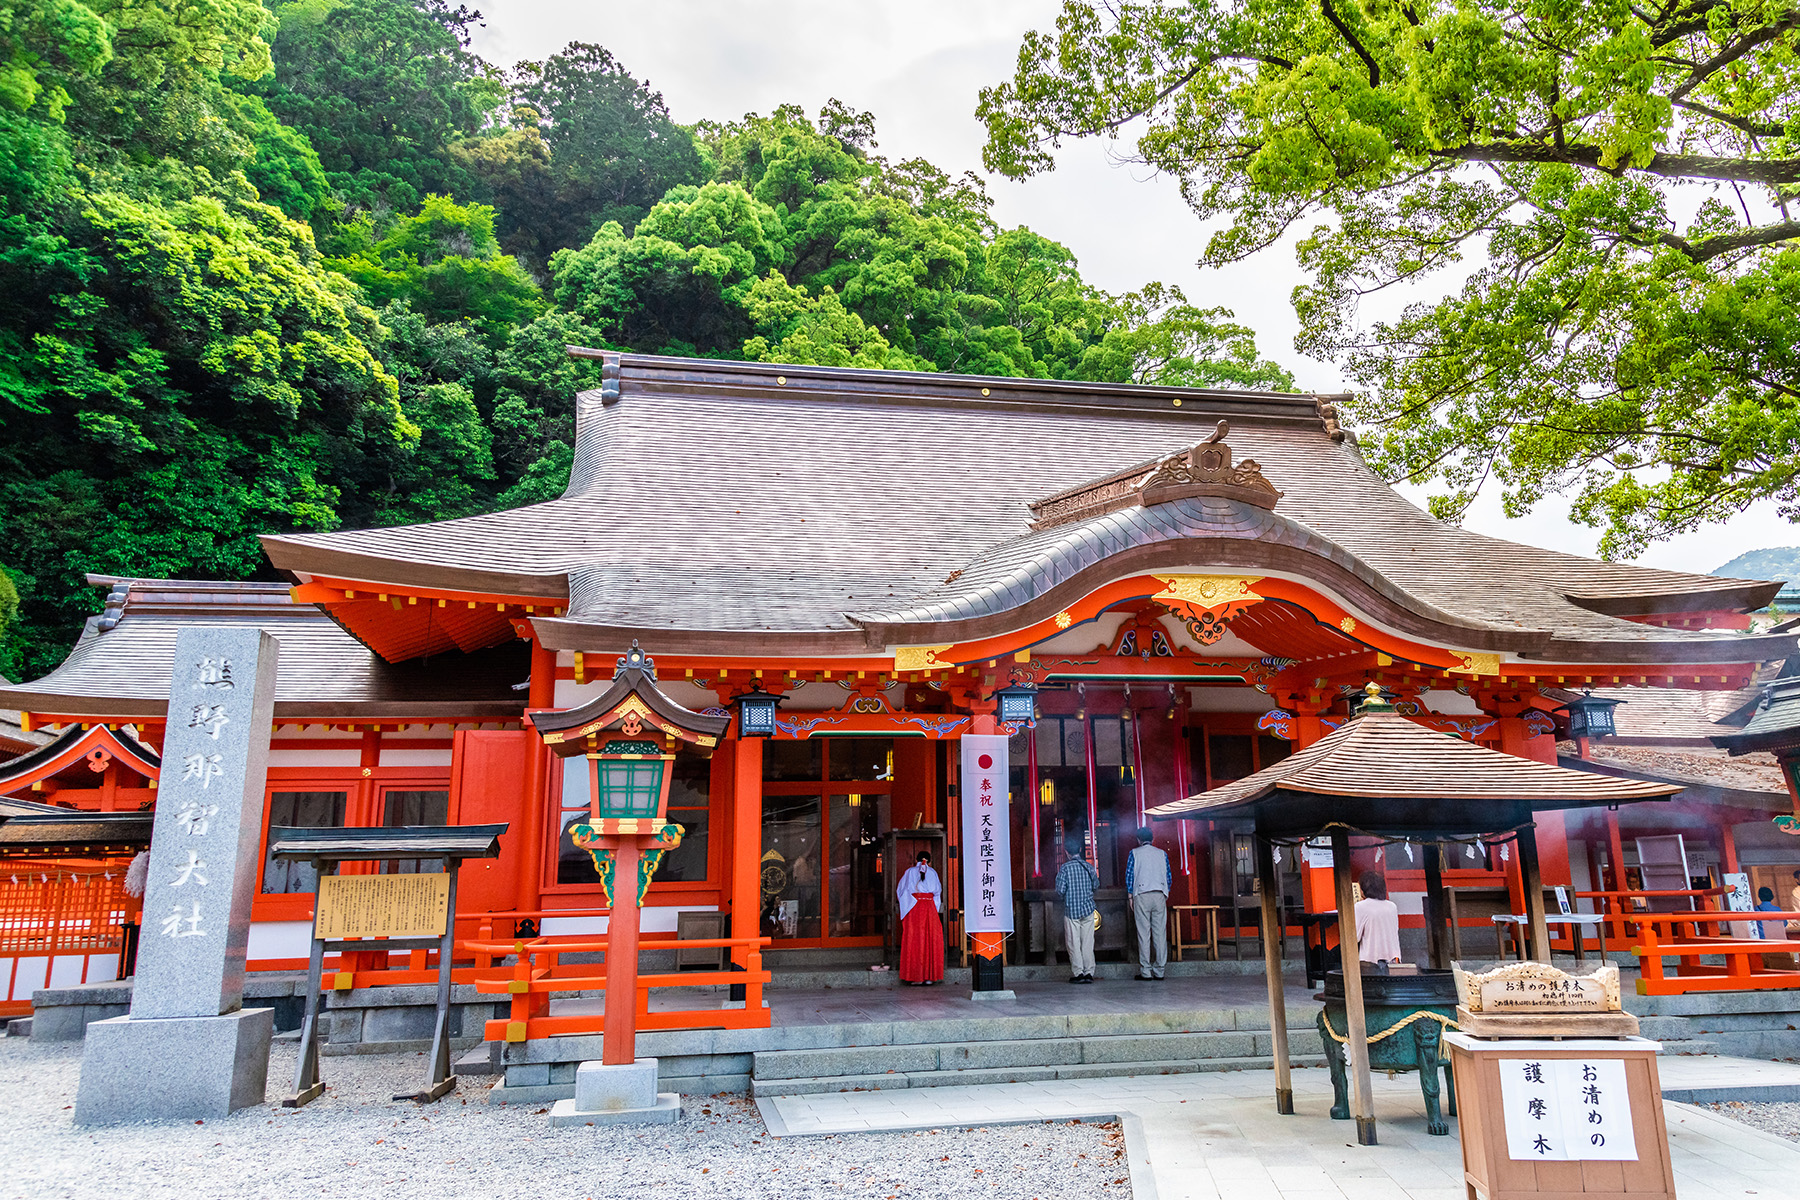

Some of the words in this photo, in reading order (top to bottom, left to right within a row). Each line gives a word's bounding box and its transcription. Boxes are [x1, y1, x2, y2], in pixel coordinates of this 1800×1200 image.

[160, 656, 235, 938] 熊野那智大社
[980, 778, 993, 807] 奉祝
[980, 814, 996, 917] 天皇陛下御即位
[1506, 980, 1585, 992] お清めの護摩木
[1522, 1062, 1552, 1155] 護摩木
[1581, 1063, 1605, 1147] お清めの
